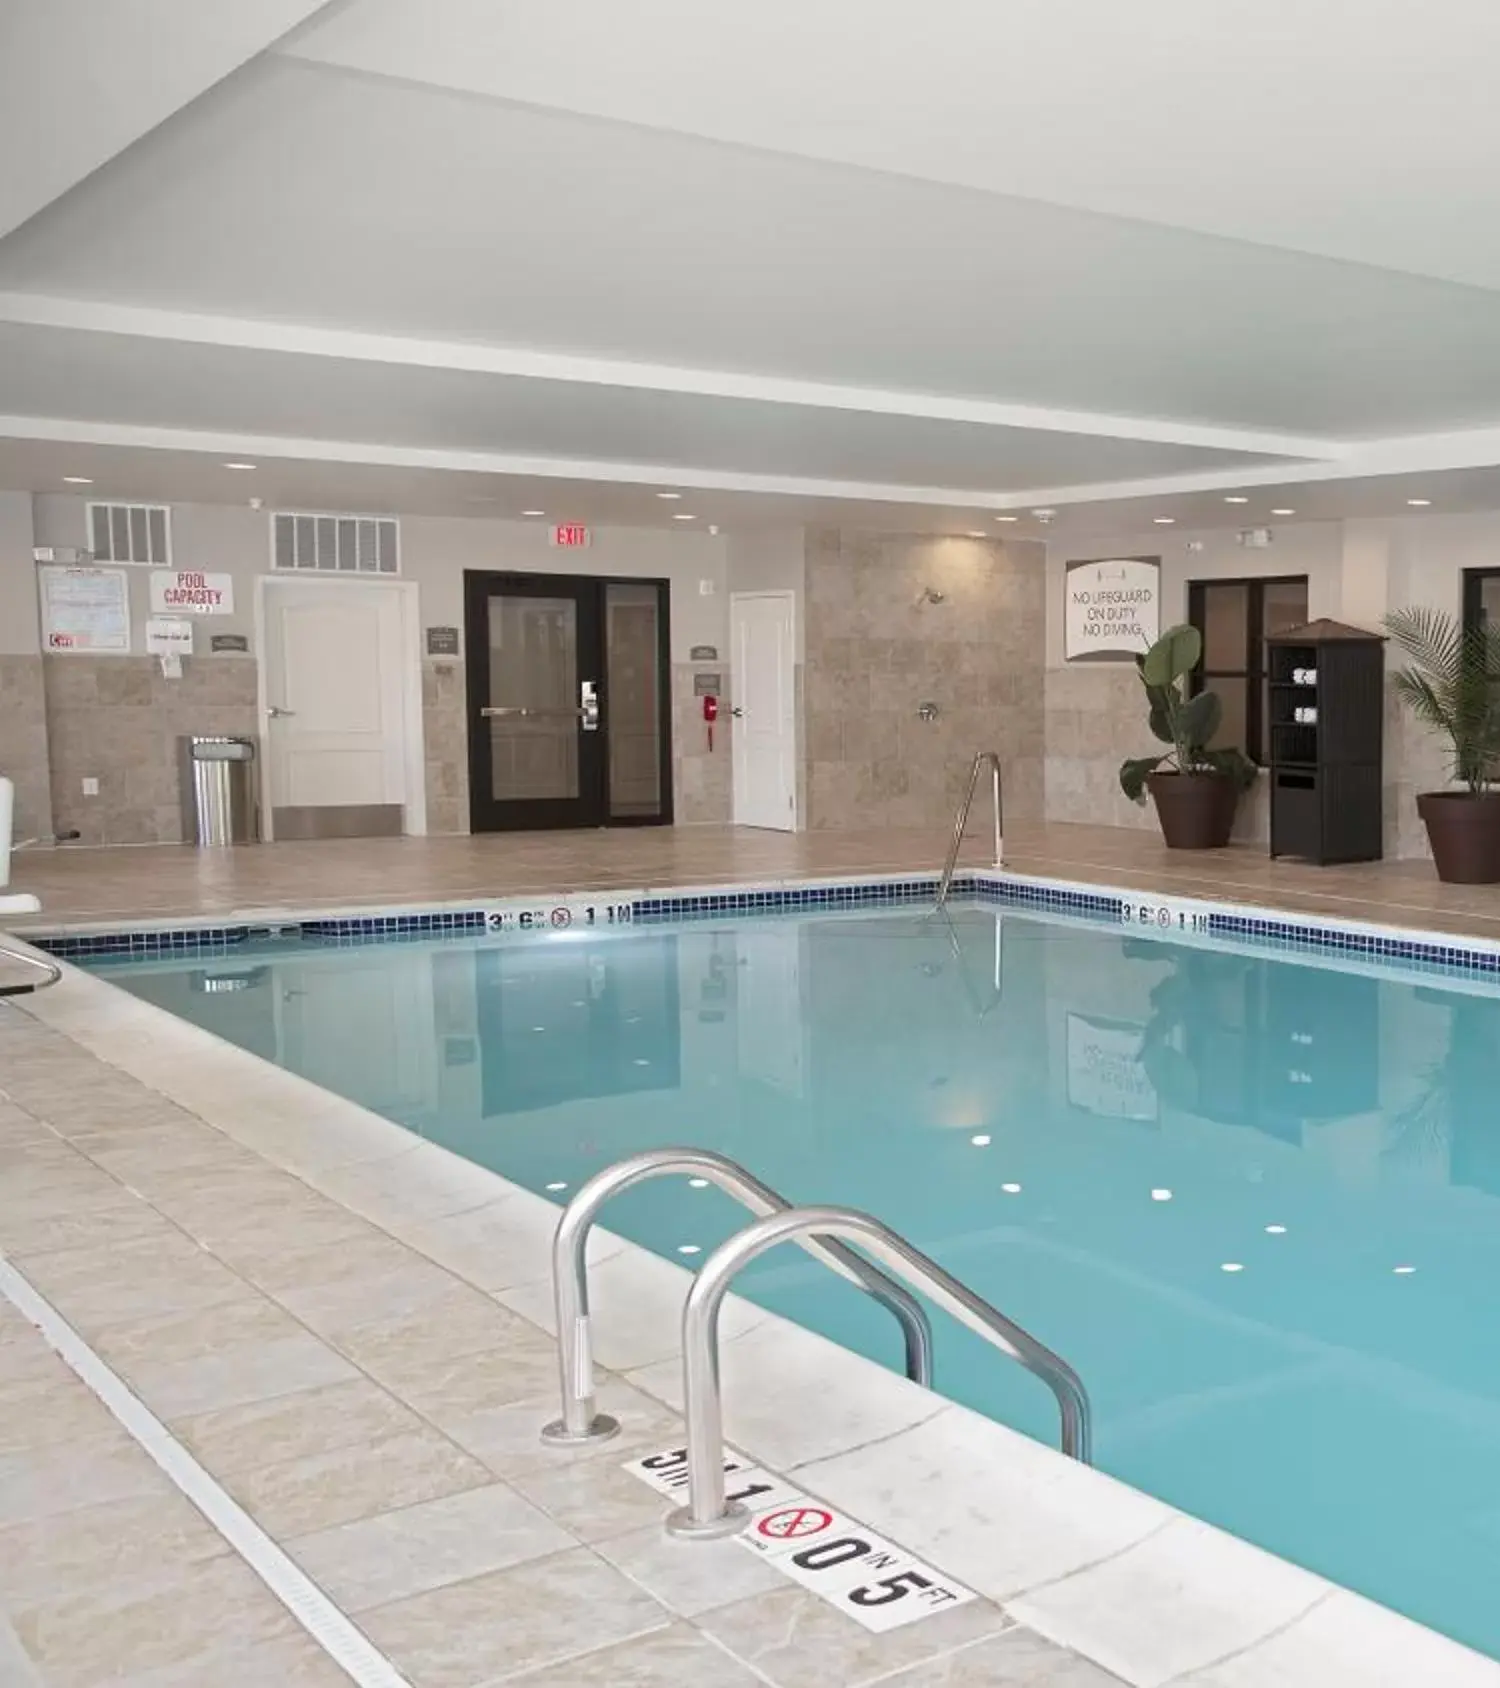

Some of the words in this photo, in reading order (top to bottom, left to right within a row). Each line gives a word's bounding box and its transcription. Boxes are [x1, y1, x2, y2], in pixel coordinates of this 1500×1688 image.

[557, 527, 585, 545] EXIT
[178, 573, 208, 588] POOL
[164, 589, 222, 604] CAPACITY
[1072, 591, 1091, 604] NO
[1093, 588, 1152, 604] LIFEGUARD
[1087, 606, 1105, 620] ON
[1107, 606, 1136, 620] DUTY
[1083, 623, 1100, 636] NO
[1103, 622, 1141, 636] DIVING
[791, 1537, 872, 1571] 0
[864, 1551, 899, 1569] IN
[848, 1571, 934, 1607] 5
[918, 1586, 958, 1607] FT
